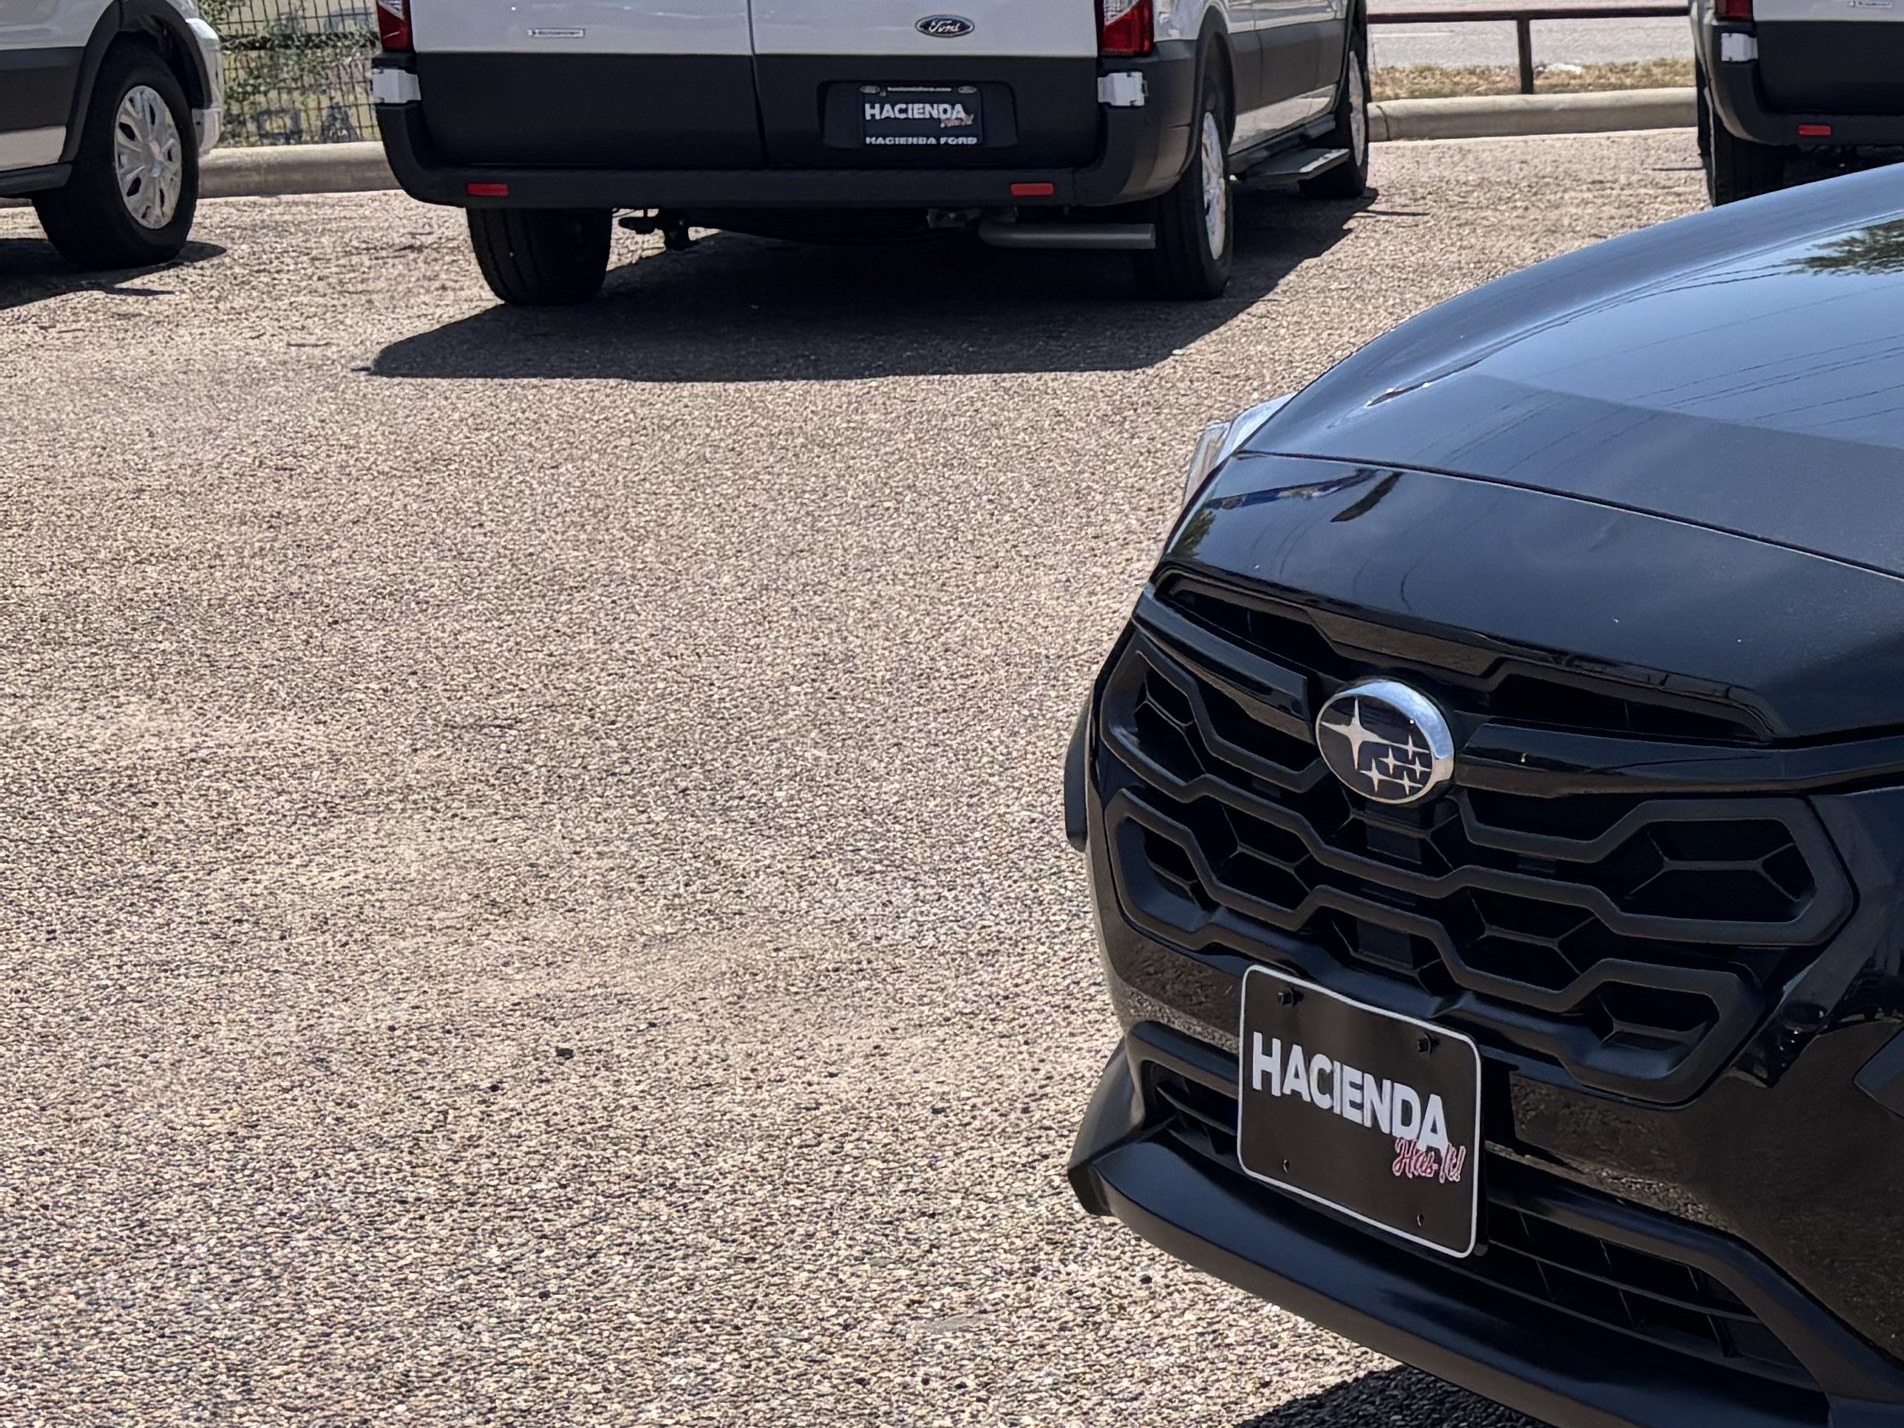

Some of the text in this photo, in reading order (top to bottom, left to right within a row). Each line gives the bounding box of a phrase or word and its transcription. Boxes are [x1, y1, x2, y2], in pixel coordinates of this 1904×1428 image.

[865, 103, 966, 120] HACIENDA
[1252, 1031, 1449, 1156] HACIENDA
[1392, 1138, 1438, 1179] Has
